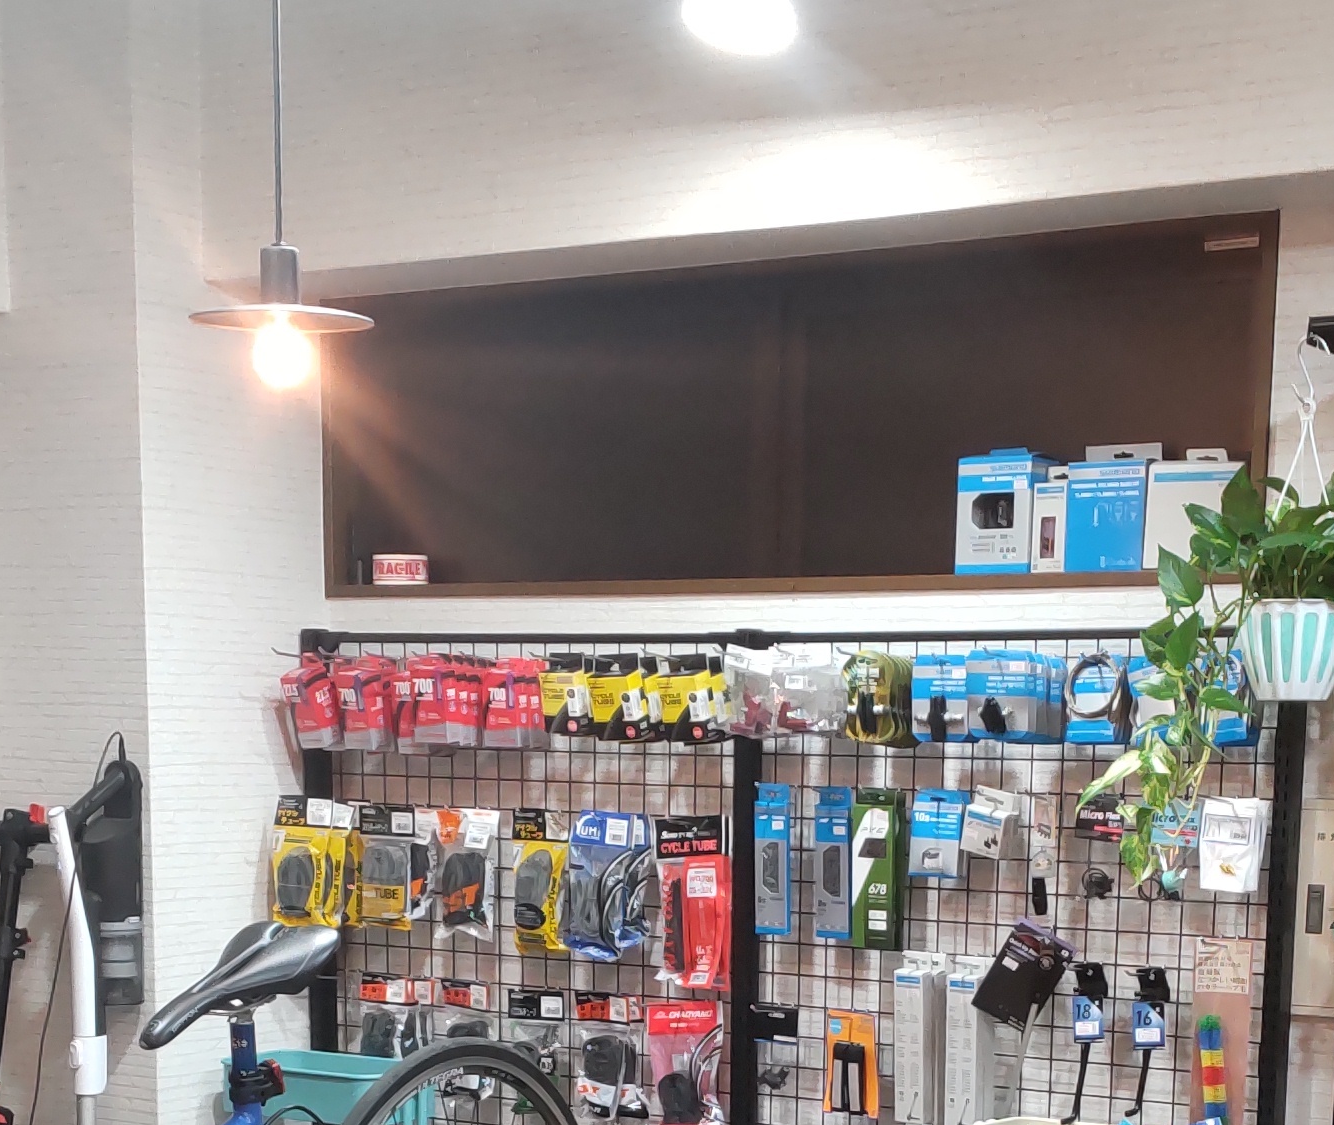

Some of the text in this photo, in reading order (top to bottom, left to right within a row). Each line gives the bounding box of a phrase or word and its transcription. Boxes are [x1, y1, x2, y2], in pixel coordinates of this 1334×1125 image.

[660, 839, 717, 853] CYCLE TUBE
[375, 888, 399, 899] TUBE
[868, 883, 887, 894] 678
[1076, 1004, 1091, 1020] 18
[1136, 1010, 1153, 1026] 16
